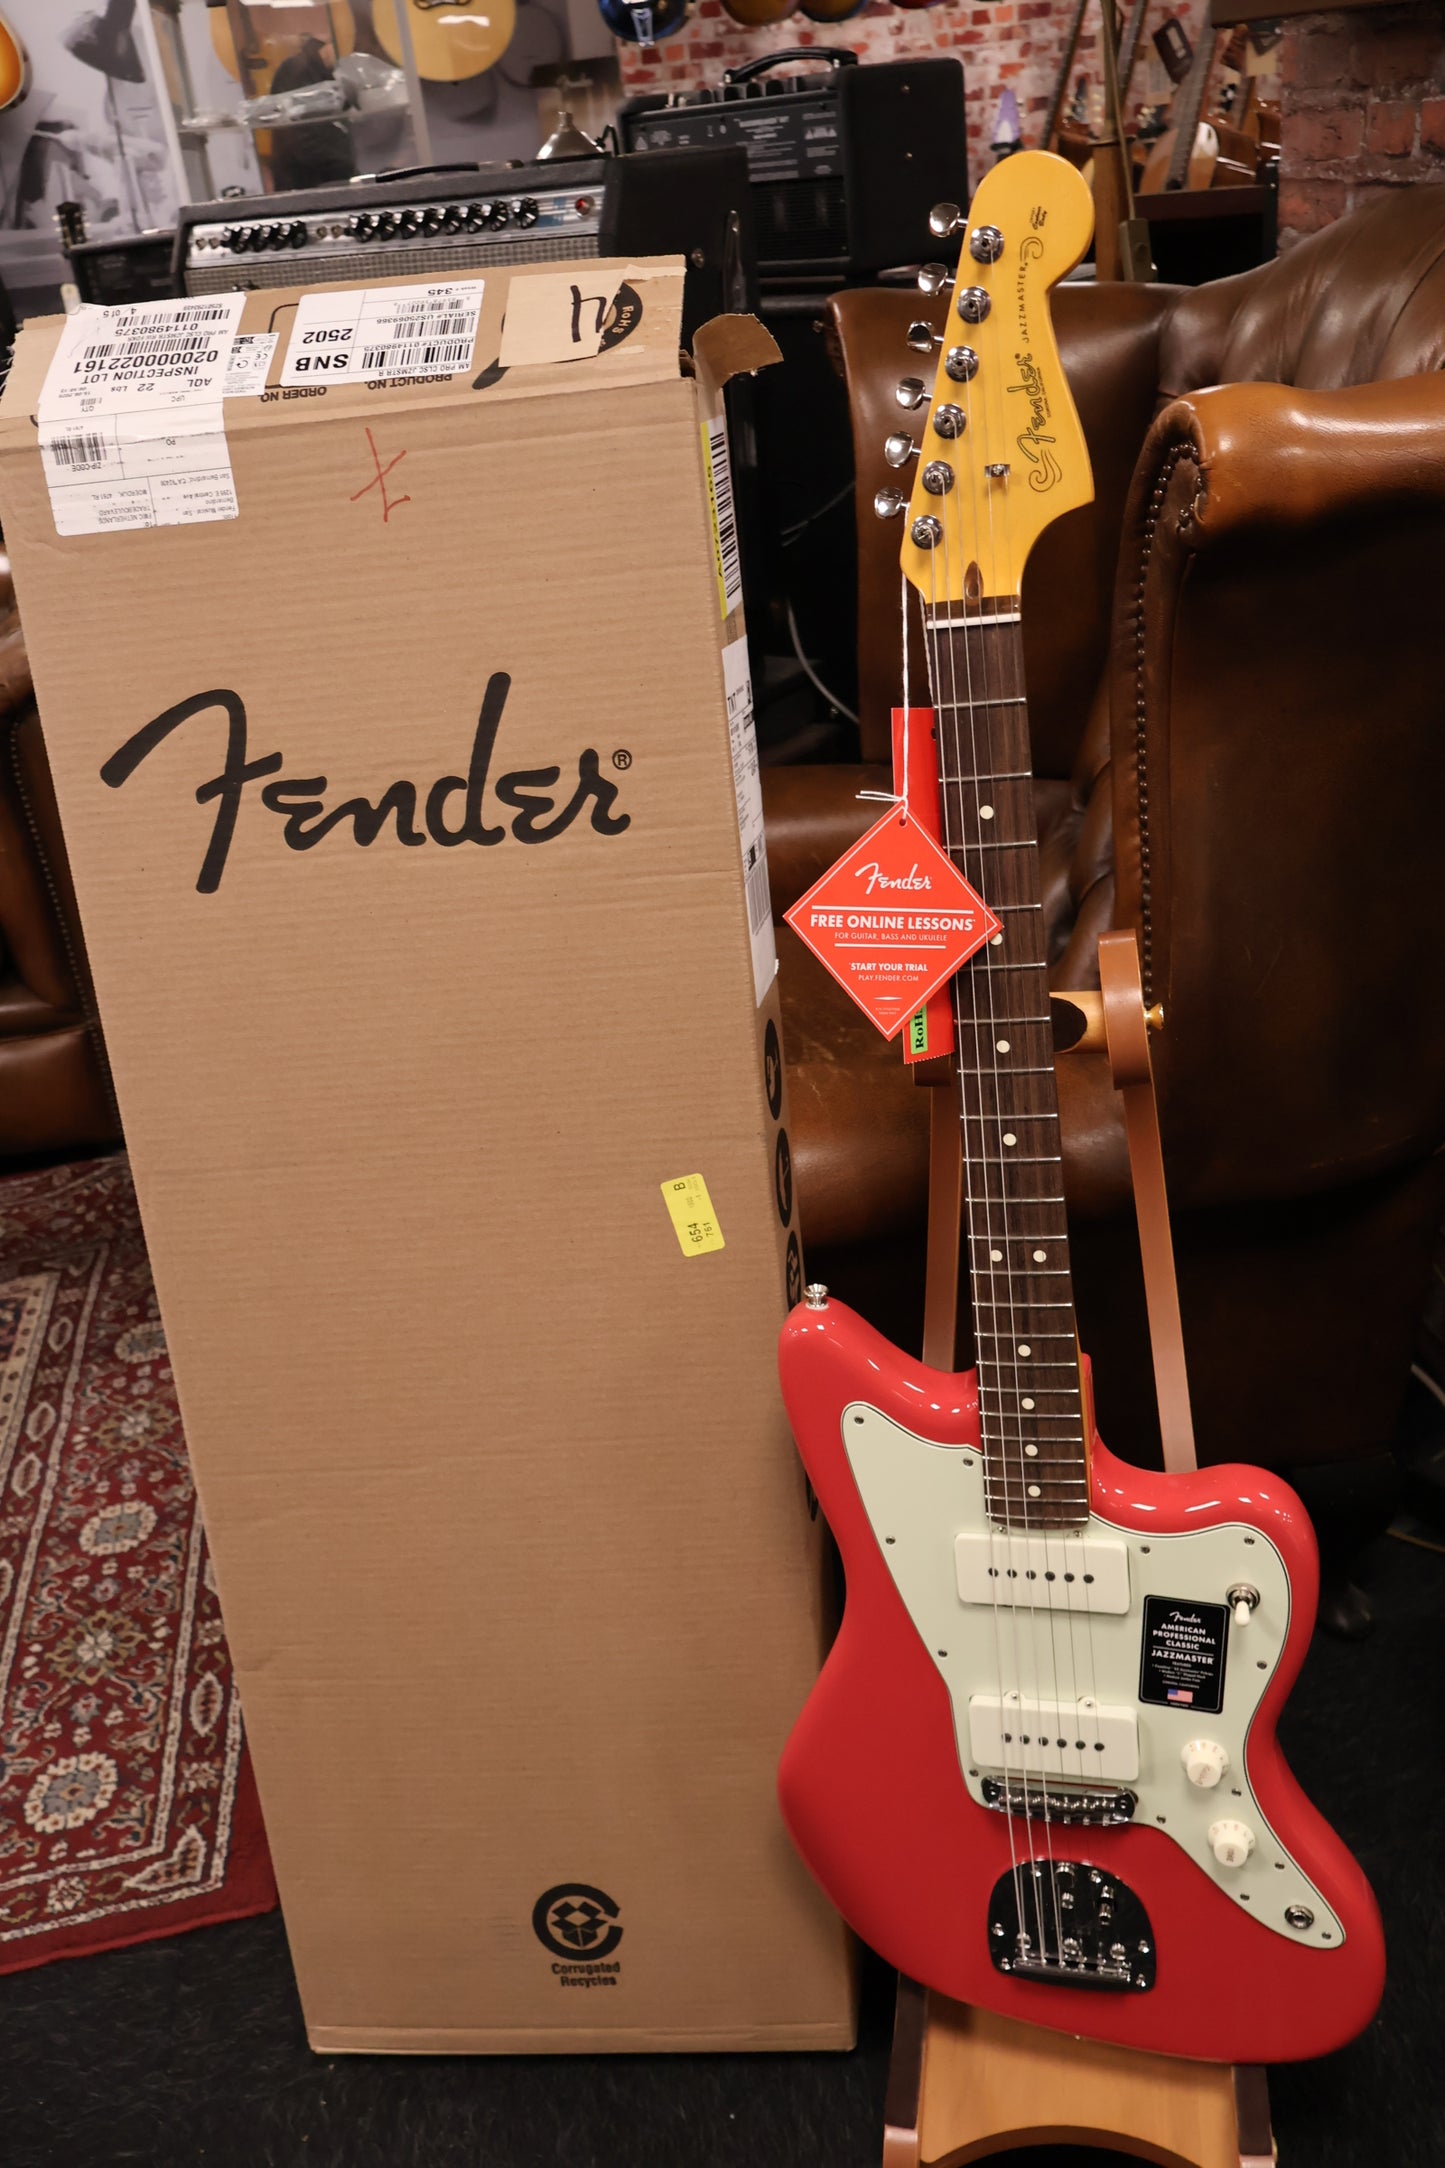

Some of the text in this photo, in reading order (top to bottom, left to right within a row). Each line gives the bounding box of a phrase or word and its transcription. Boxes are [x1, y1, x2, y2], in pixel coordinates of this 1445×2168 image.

[427, 287, 453, 296] 345
[1016, 265, 1029, 344] JAZZMASTER
[436, 310, 477, 319] SERIAL#
[612, 305, 634, 334] RoHS
[115, 323, 198, 337] 0114980375
[302, 328, 354, 344] 2502
[364, 338, 474, 352] PRODUCT# 0114980375
[73, 350, 219, 374] 020000022161
[295, 354, 349, 372] SNB
[440, 364, 456, 372] PRO
[81, 366, 199, 384] INSPECTION LOT
[387, 367, 417, 376] JZMSTR
[419, 365, 438, 374] CLSC
[137, 383, 155, 392] 22
[187, 378, 212, 387] AQL
[364, 374, 452, 391] PRODUCT NO.
[282, 387, 327, 400] ORDER
[1006, 353, 1056, 463] Fender
[854, 862, 932, 895] Fender
[810, 913, 974, 932] FREE ONLINE LESSONS
[834, 931, 849, 939] FOR
[881, 933, 899, 941] BASS
[900, 933, 917, 941] AND
[919, 934, 947, 942] UKULELE
[878, 963, 903, 971] YOUR
[904, 963, 928, 972] TRIAL
[673, 1182, 686, 1191] B
[687, 1223, 703, 1243] 654
[1161, 1623, 1206, 1635] AMERICAN
[1152, 1629, 1216, 1645] PROFESSIONAL
[1166, 1639, 1200, 1650] CLASSIC
[1151, 1649, 1214, 1665] JAZZMASTER
[551, 1961, 621, 1975] Corrugated
[560, 1975, 617, 1988] Recycles
